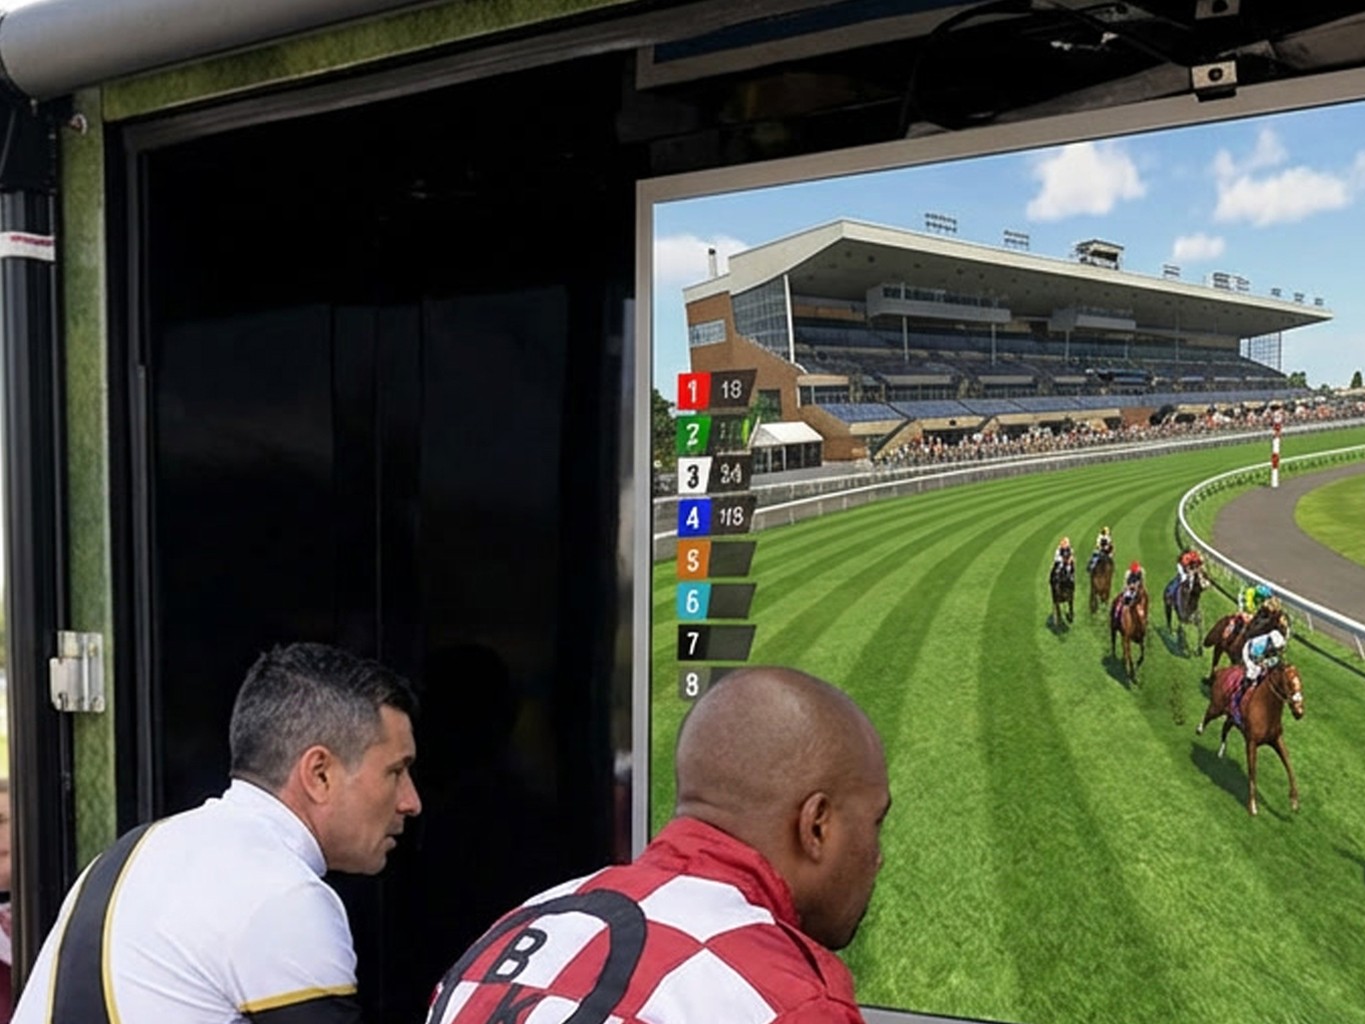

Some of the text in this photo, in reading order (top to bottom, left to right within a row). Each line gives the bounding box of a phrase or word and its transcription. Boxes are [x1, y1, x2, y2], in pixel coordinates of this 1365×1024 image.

[688, 379, 698, 403] 1
[686, 423, 700, 447] 2
[687, 463, 700, 490] 3
[686, 506, 700, 530] 4
[686, 590, 699, 614] 6
[687, 632, 700, 656] 7
[686, 672, 700, 697] 8
